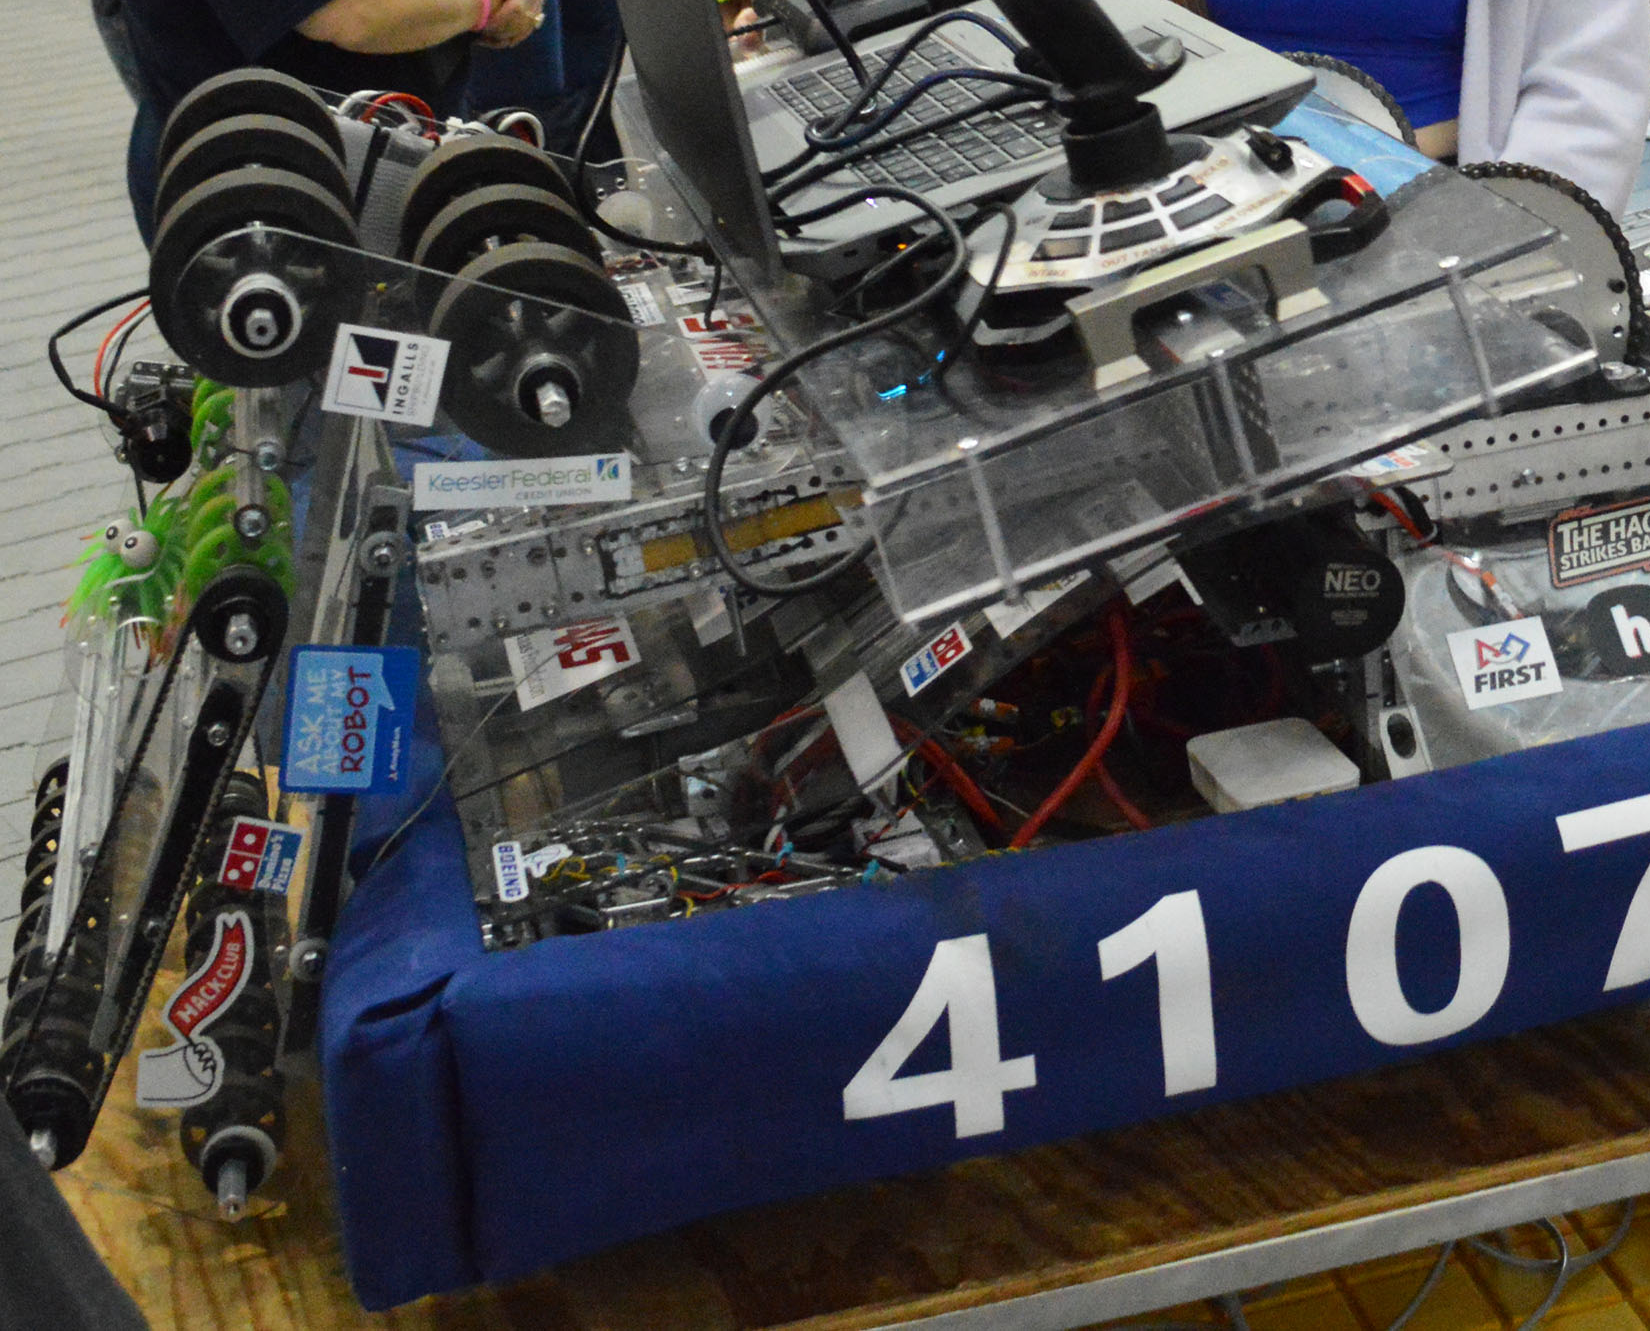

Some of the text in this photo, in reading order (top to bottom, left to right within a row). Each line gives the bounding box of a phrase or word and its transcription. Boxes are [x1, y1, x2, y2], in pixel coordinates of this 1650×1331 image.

[393, 343, 418, 415] INGALLS
[1557, 521, 1603, 553] THE
[1560, 540, 1627, 570] STRIKES
[1325, 570, 1381, 591] NEO
[1474, 661, 1546, 693] FIRST
[296, 669, 328, 774] ASK ME
[322, 669, 347, 775] ABOUT MY
[340, 666, 371, 773] ROBOT
[498, 844, 522, 899] BOEING
[216, 942, 241, 980] CLUB
